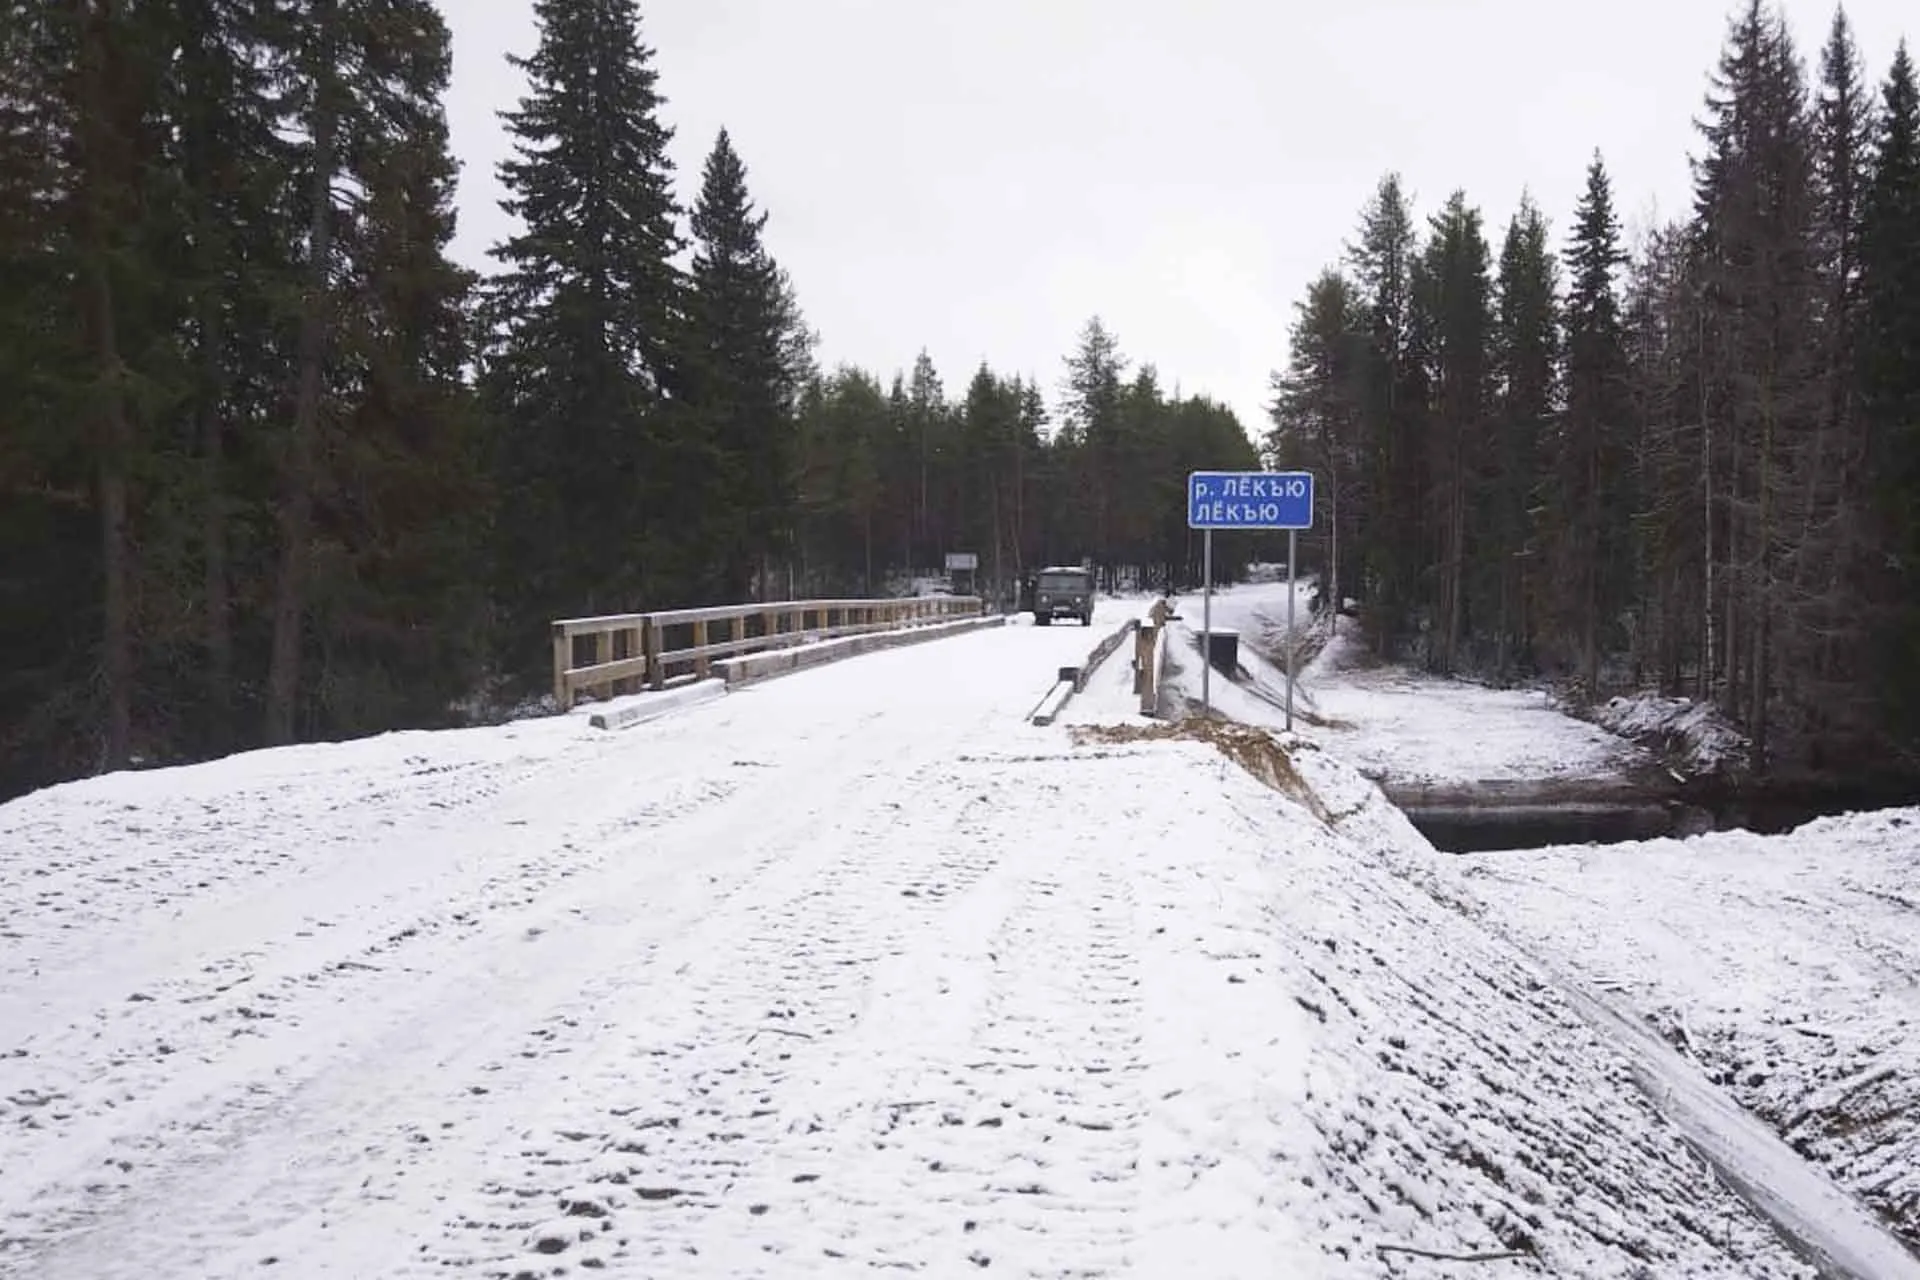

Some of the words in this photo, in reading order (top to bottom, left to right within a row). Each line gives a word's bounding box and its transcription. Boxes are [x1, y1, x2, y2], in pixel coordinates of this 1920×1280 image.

[1195, 482, 1215, 500] р.
[1222, 477, 1305, 497] ЛЁКЪЮ
[1195, 501, 1279, 521] ЛЁКЪЮ
